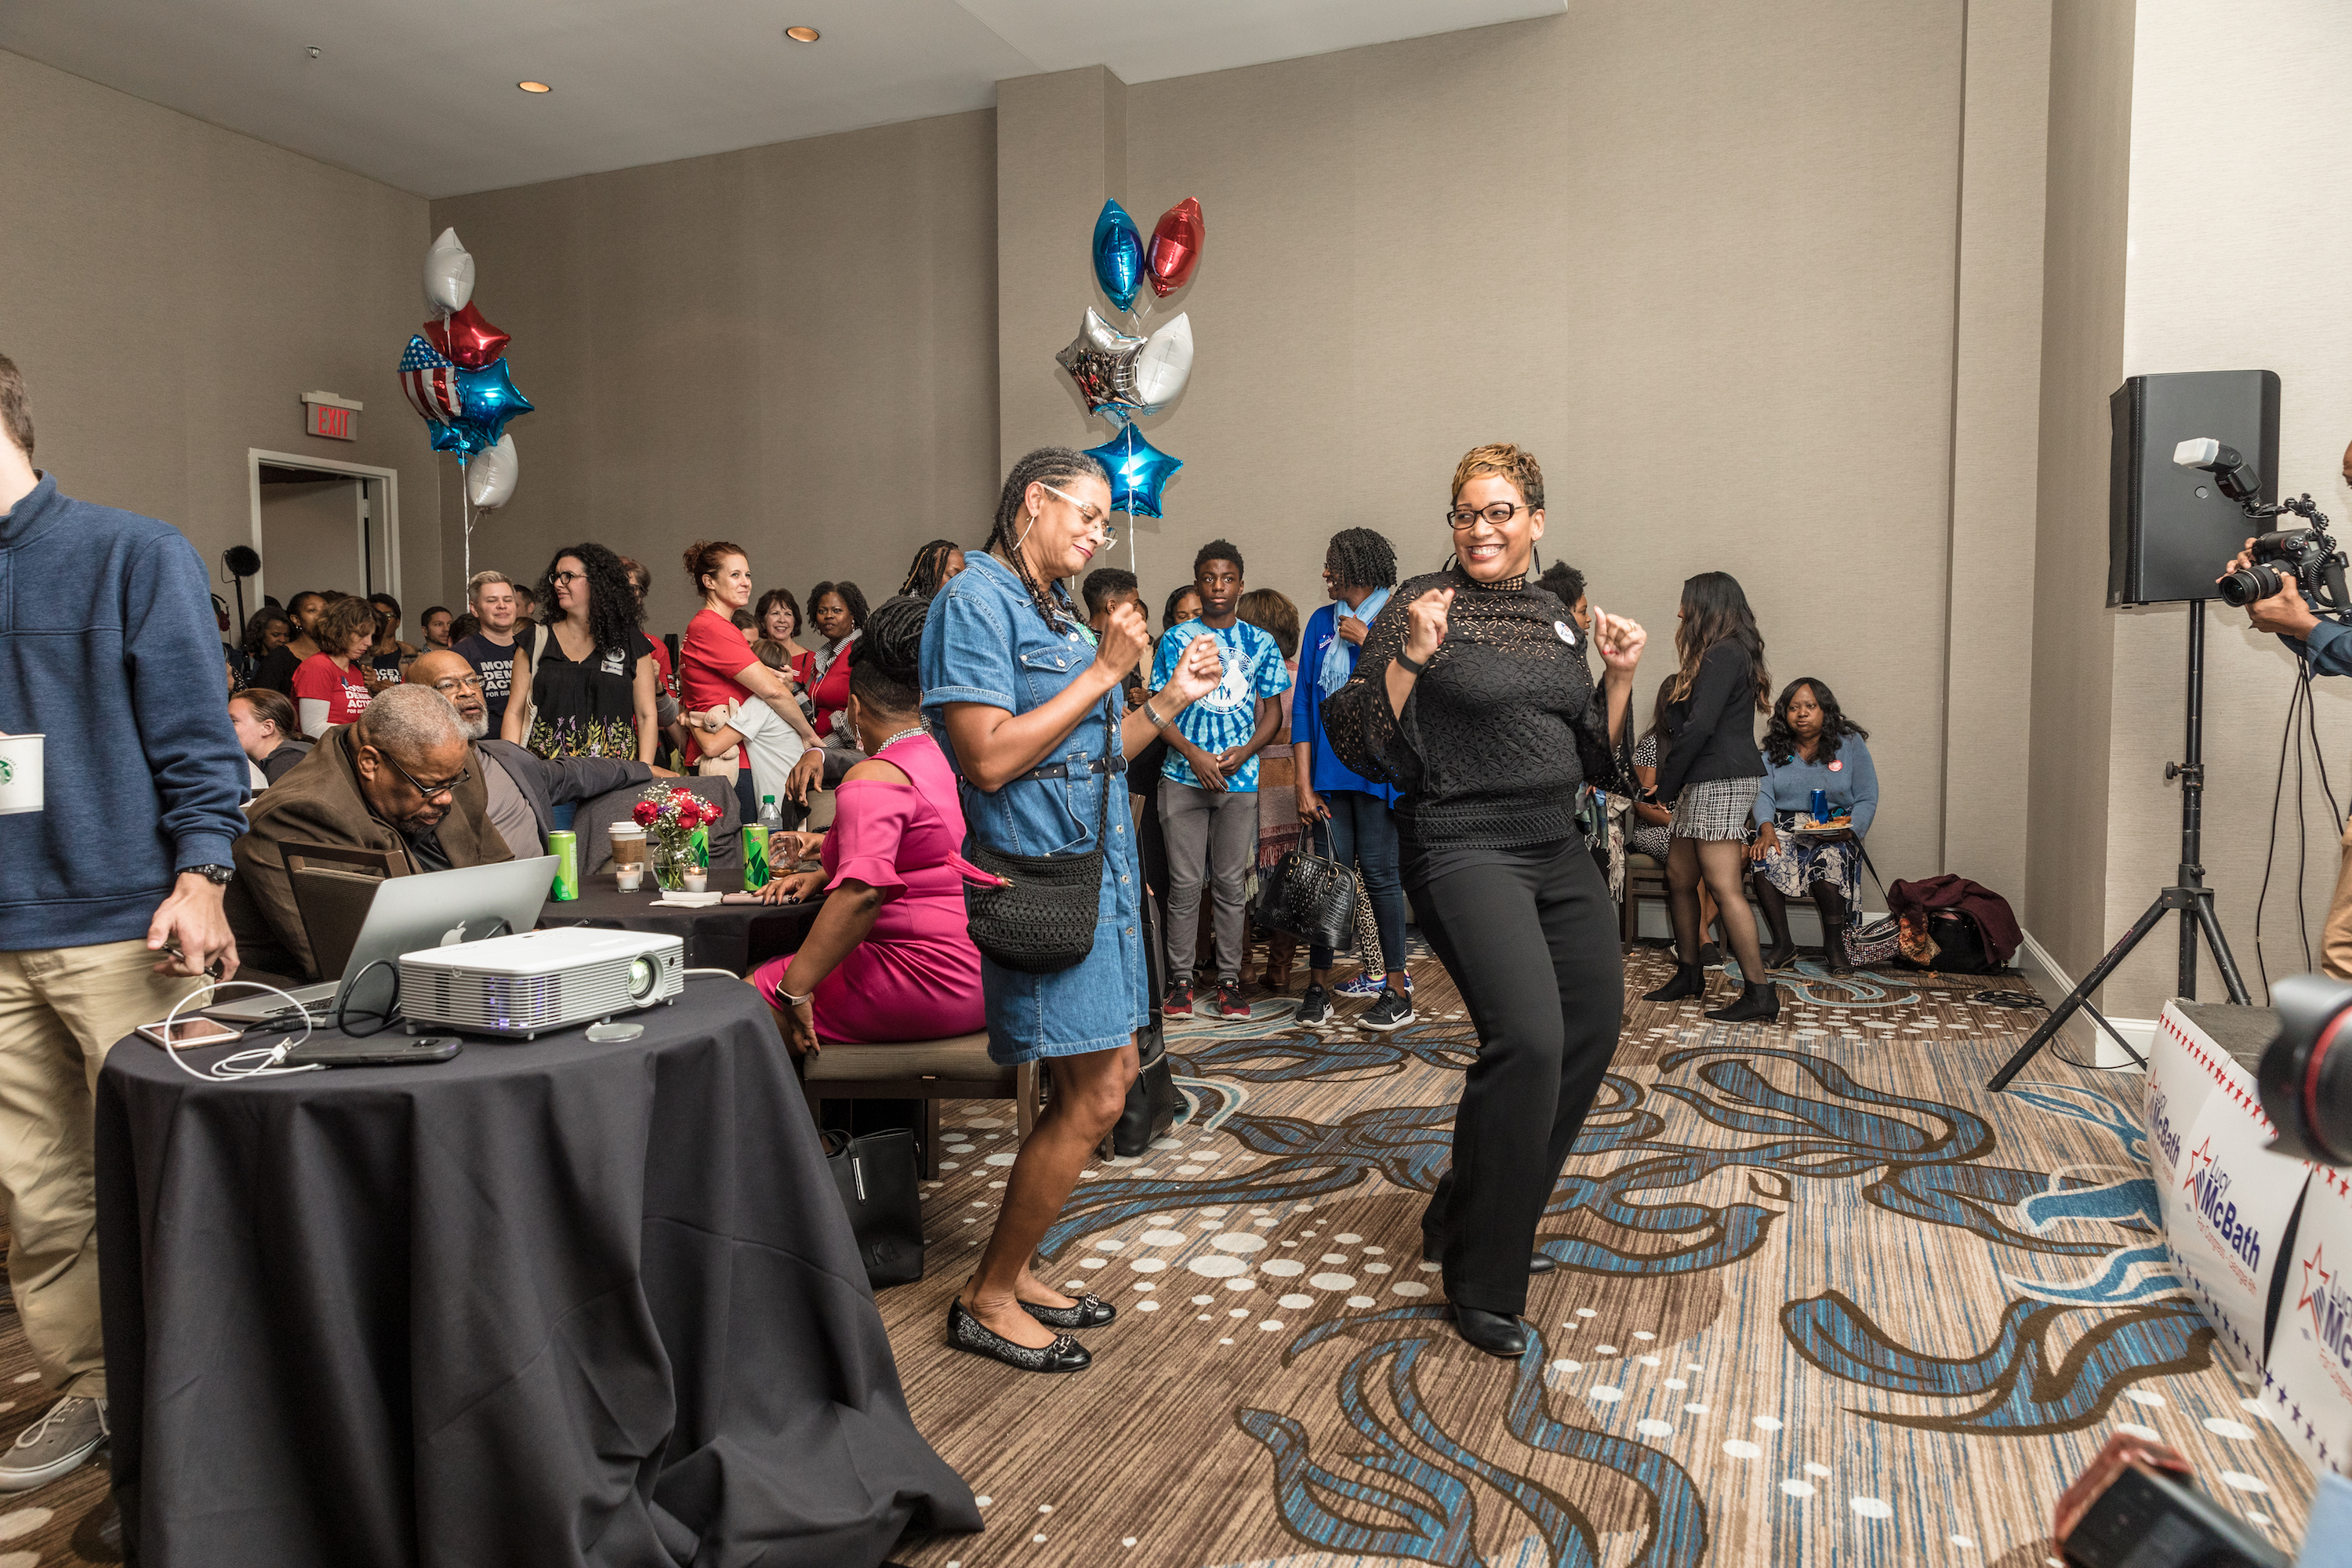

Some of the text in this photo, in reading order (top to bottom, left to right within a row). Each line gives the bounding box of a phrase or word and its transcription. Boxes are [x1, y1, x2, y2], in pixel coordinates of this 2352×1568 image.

[318, 406, 350, 437] EXIT
[2156, 1081, 2168, 1116] Lucy
[2151, 1101, 2180, 1168] McBath
[2209, 1155, 2232, 1198] Lucy
[2197, 1216, 2205, 1233] For
[2200, 1178, 2260, 1274] McBath
[2323, 1299, 2352, 1377] Mc
